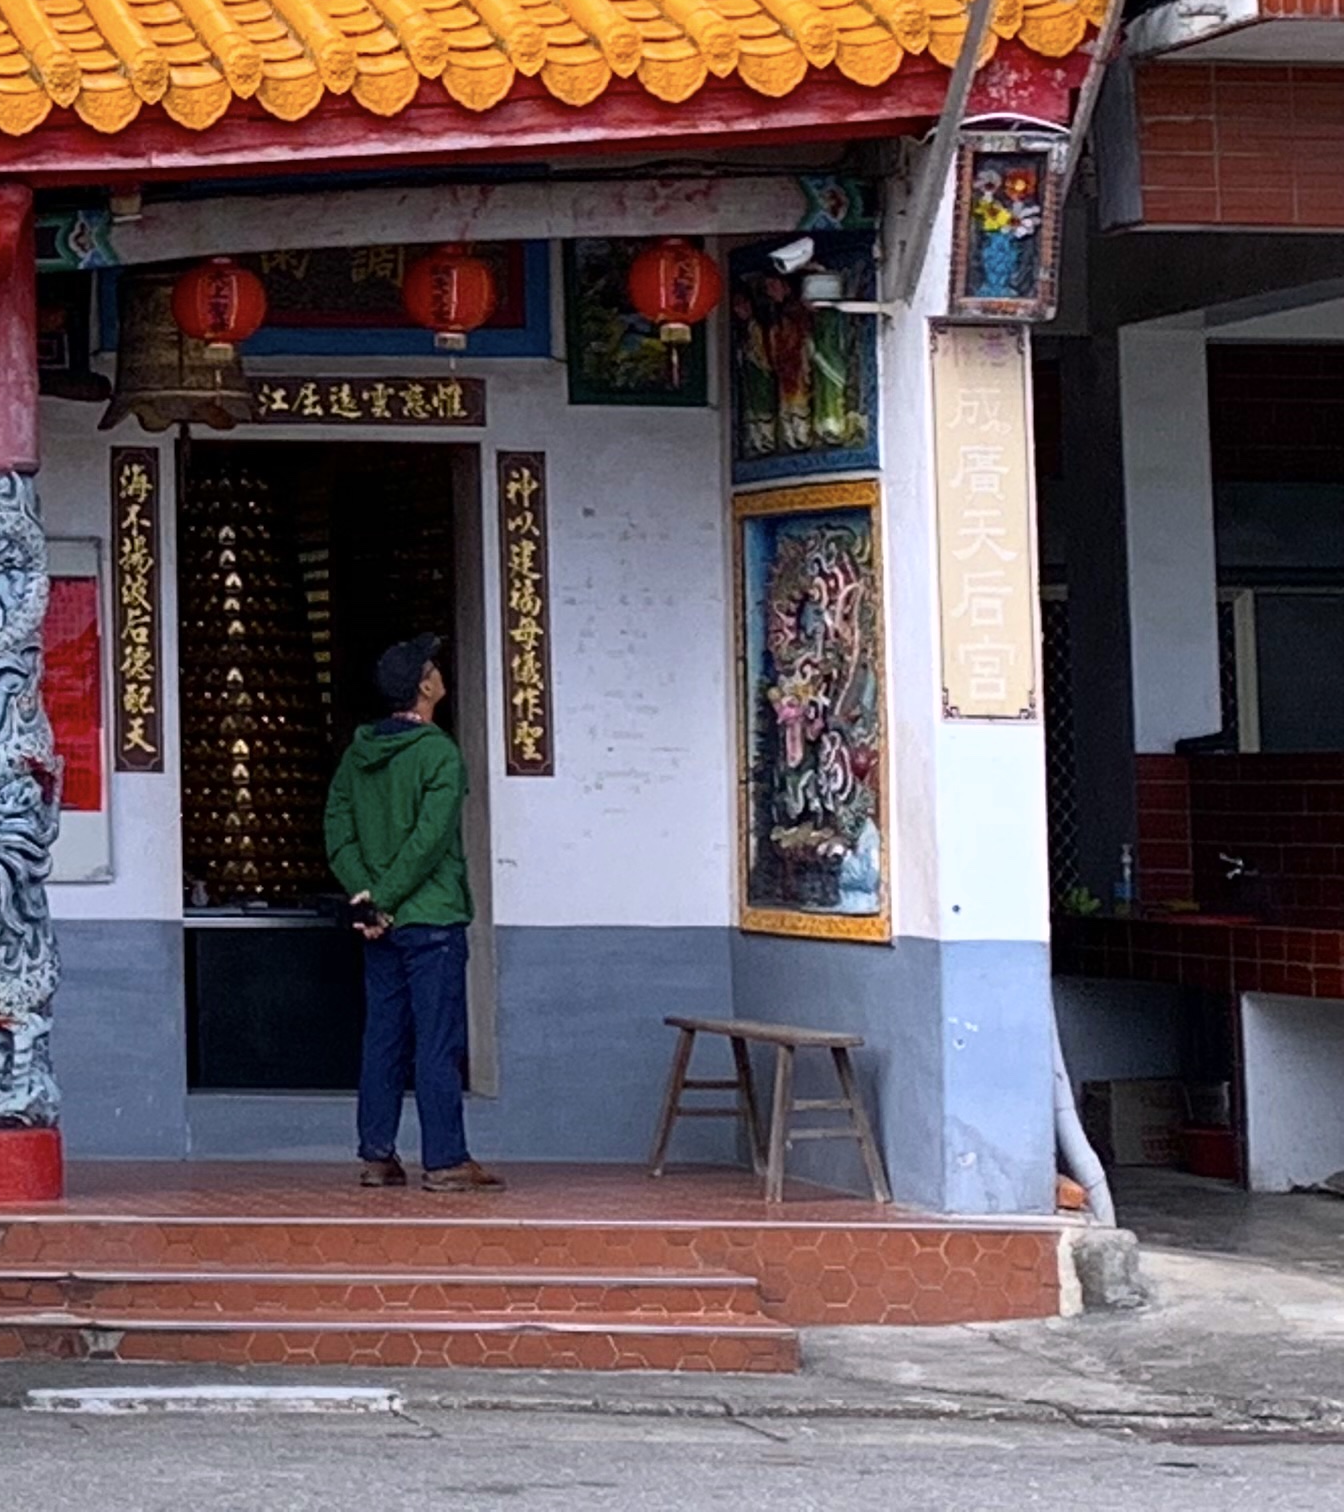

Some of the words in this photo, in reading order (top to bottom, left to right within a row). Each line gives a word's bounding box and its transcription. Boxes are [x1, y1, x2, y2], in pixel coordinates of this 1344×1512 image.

[947, 383, 1018, 702] 成廣天后宮
